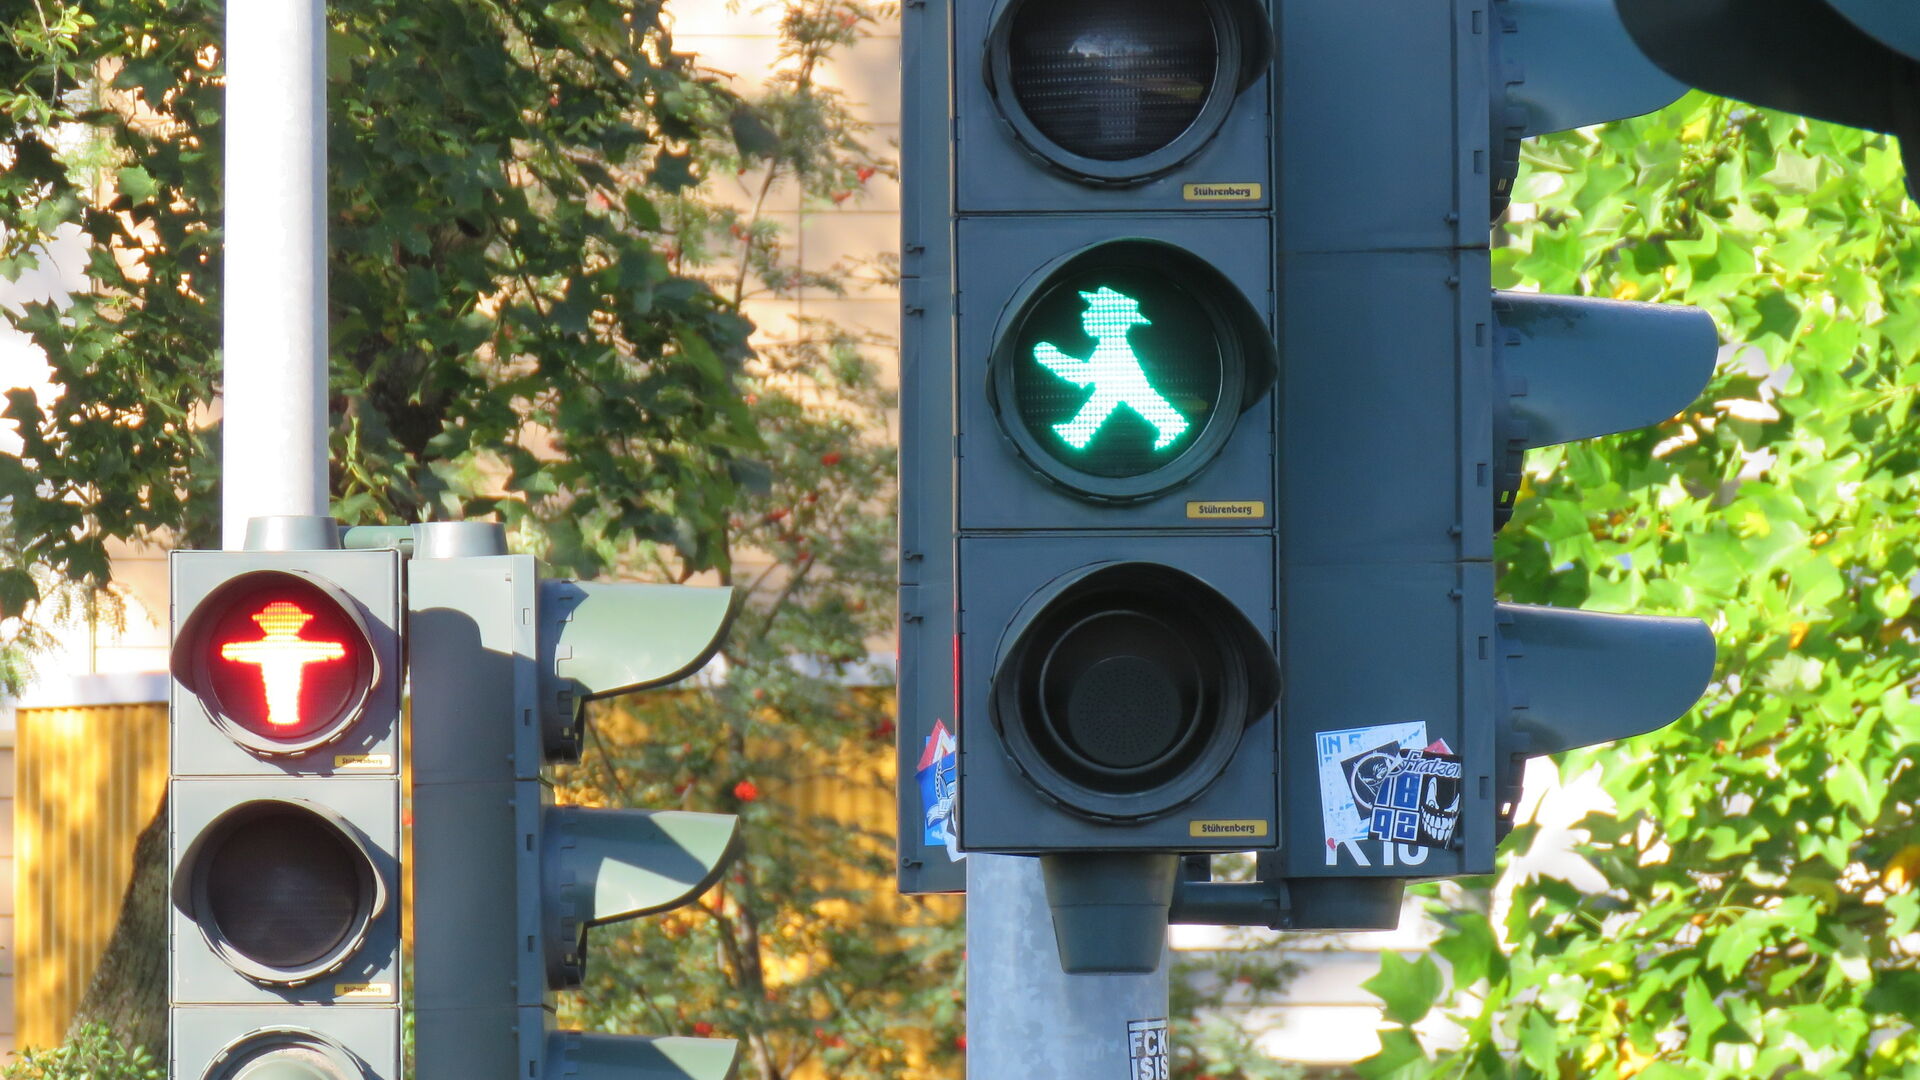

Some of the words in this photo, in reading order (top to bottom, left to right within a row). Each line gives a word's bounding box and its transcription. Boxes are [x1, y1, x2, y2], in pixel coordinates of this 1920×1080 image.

[1193, 186, 1251, 197] Stührenberg
[1199, 505, 1252, 515] Stührenberg
[1202, 823, 1255, 834] Stührenberg
[1129, 1029, 1168, 1057] FCK
